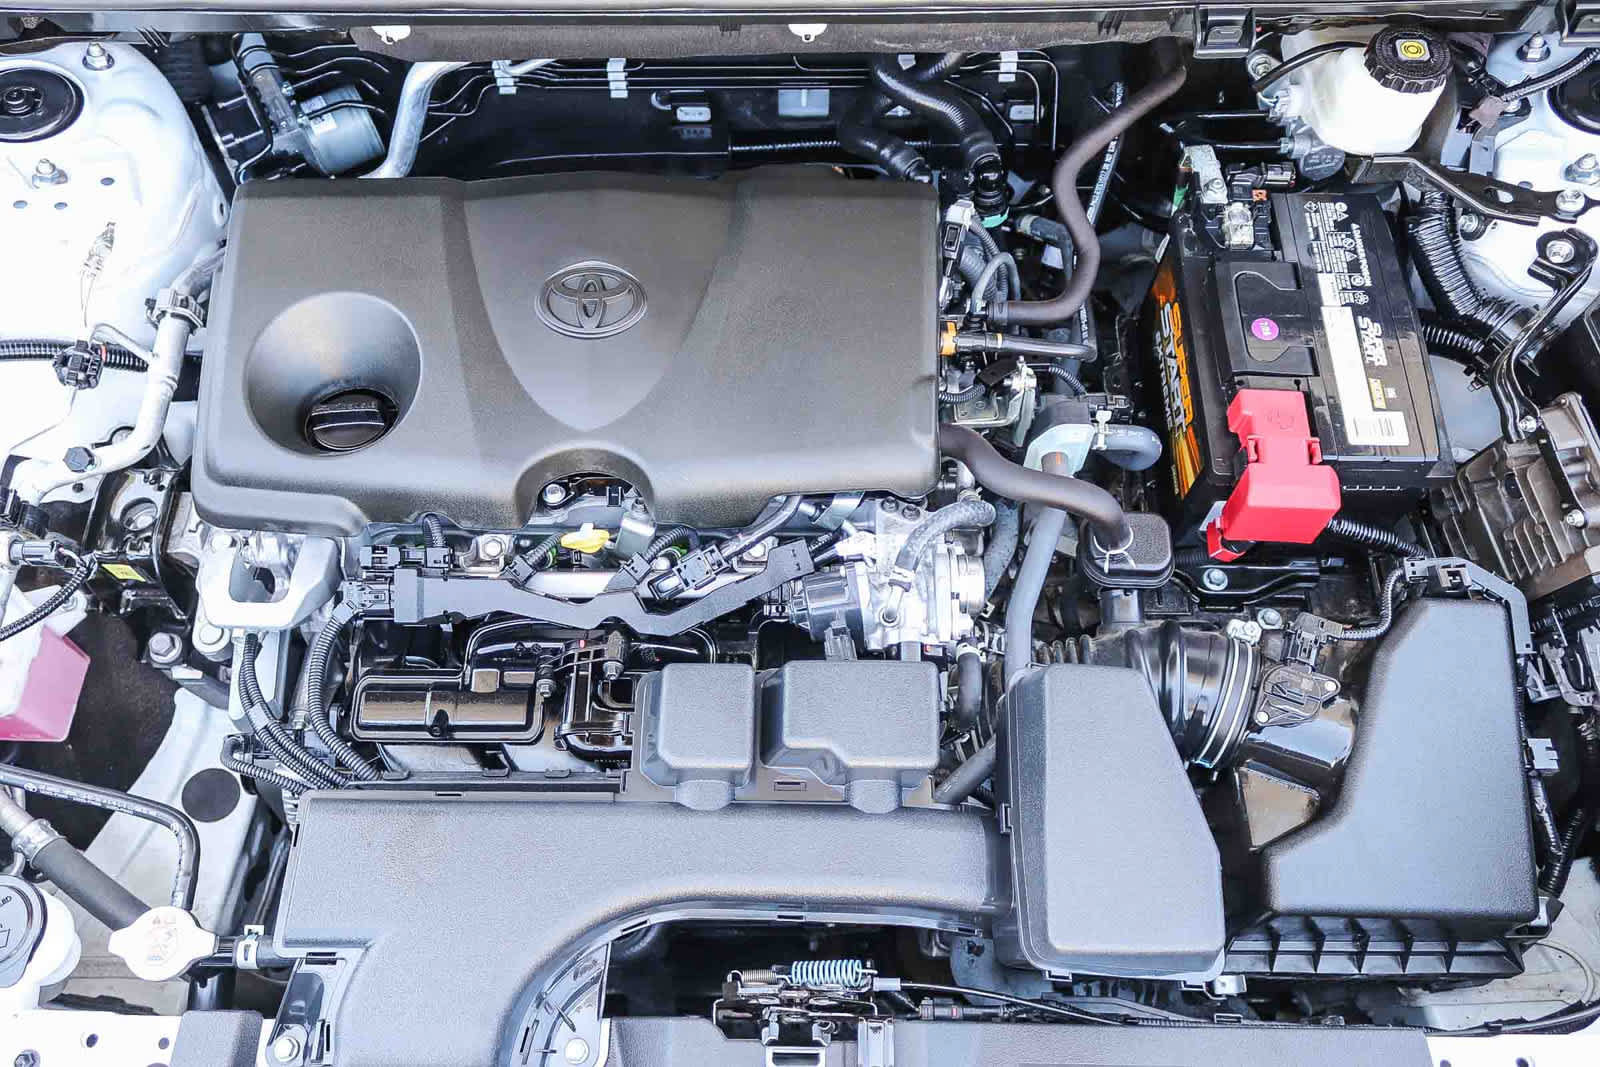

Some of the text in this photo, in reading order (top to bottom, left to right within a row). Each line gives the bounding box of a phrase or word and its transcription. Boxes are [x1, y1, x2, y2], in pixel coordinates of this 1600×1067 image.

[1155, 331, 1172, 431] EXTREME
[1161, 302, 1186, 432] START
[1173, 302, 1193, 425] SUPER
[1357, 315, 1376, 364] START
